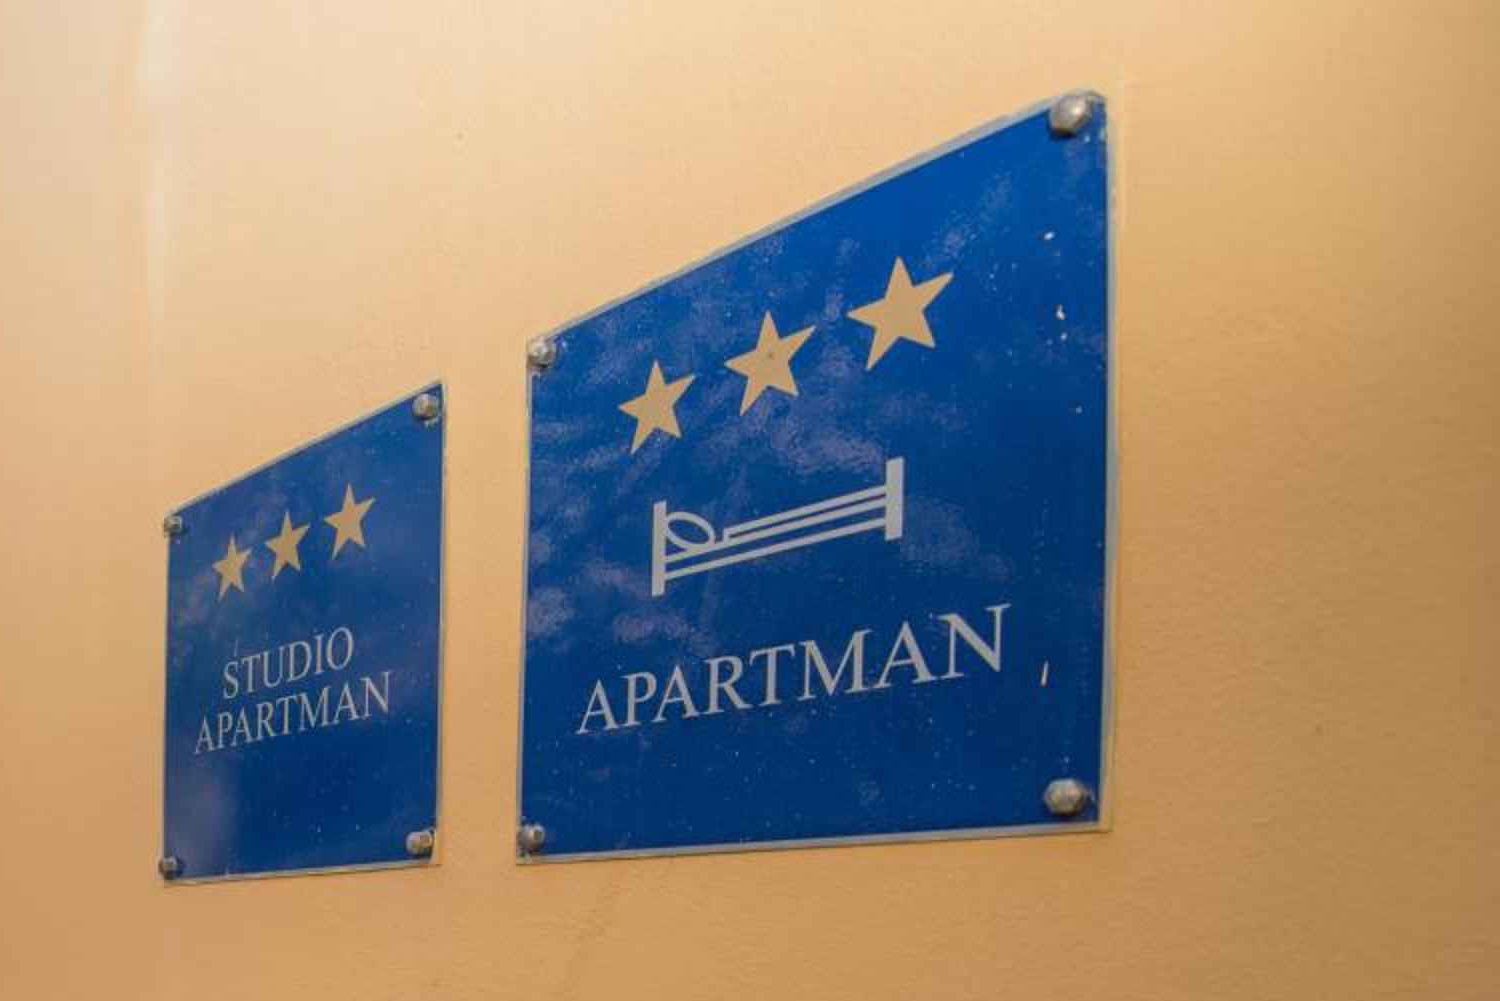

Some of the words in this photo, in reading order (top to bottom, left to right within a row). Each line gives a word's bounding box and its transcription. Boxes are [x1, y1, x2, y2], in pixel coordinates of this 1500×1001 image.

[223, 626, 355, 700] STUDIO
[576, 603, 1011, 736] APARTMAN
[194, 671, 392, 756] APARTMAN
